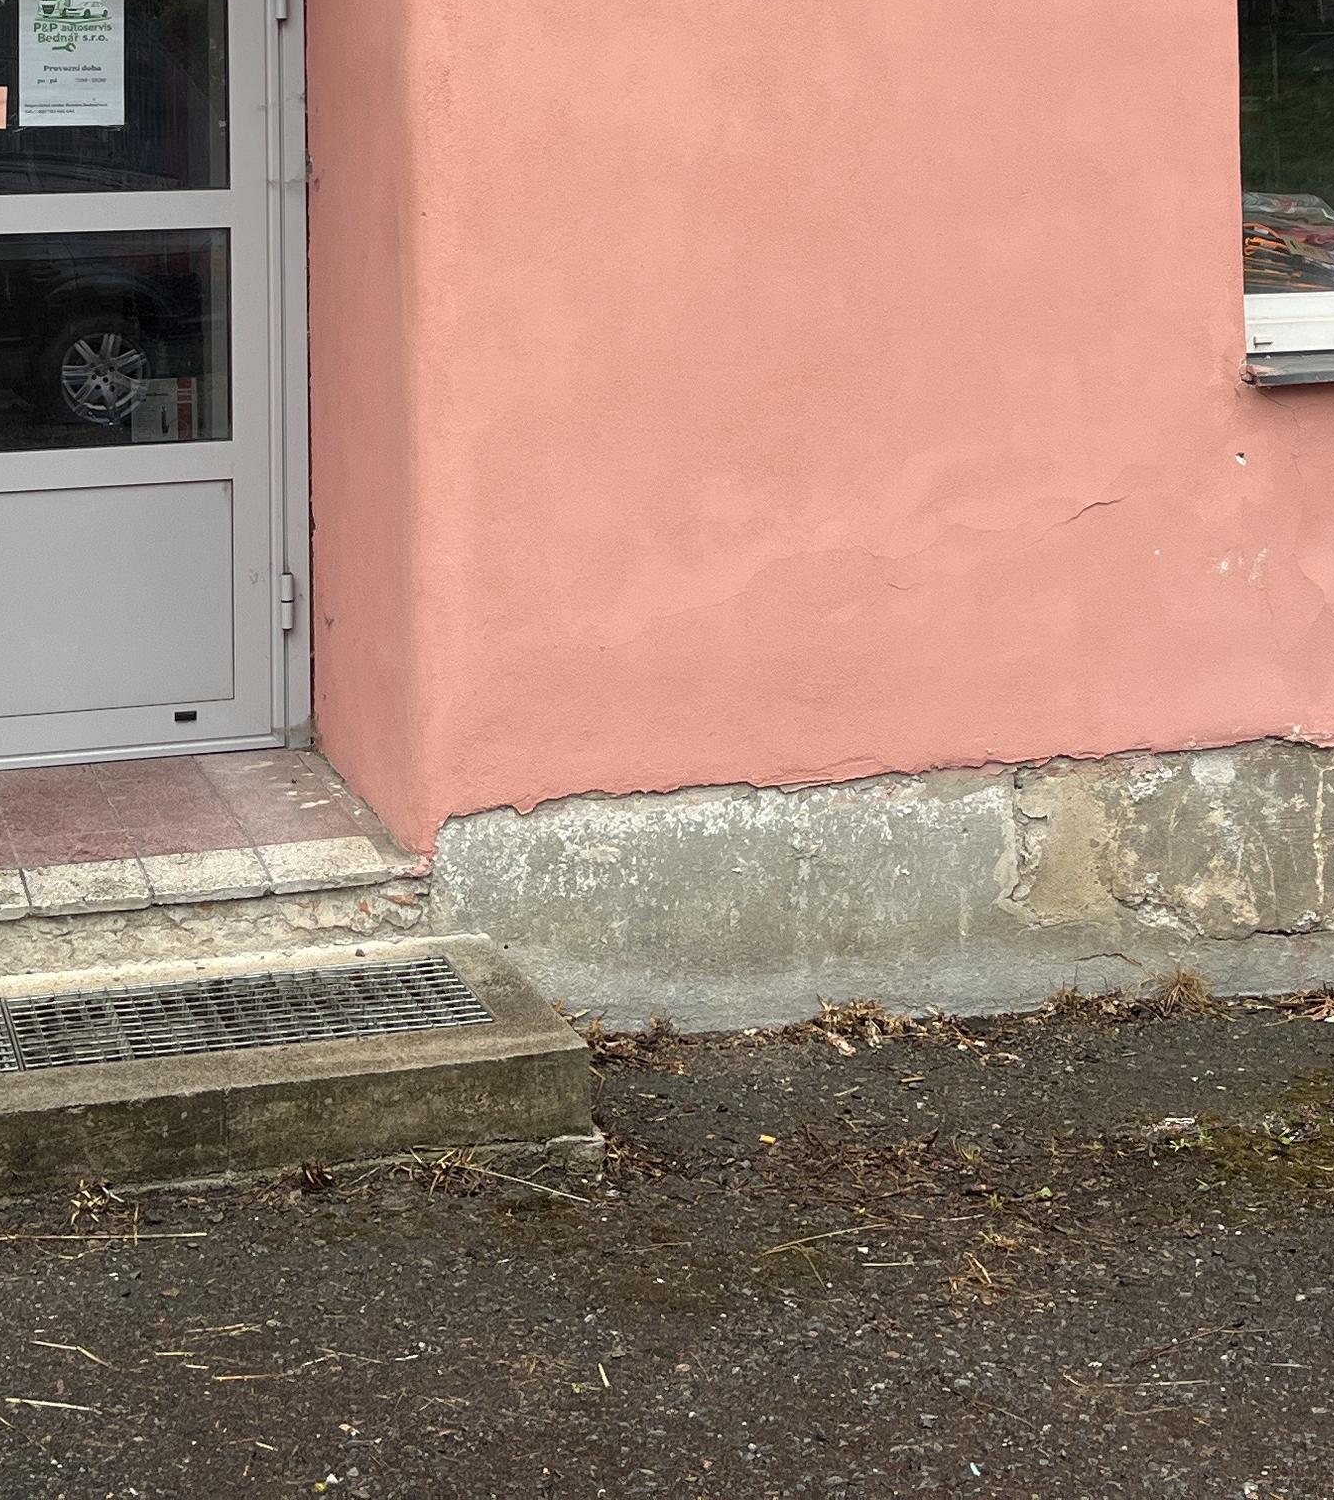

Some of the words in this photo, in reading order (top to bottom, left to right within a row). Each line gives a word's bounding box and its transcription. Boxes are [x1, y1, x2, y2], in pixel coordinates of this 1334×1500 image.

[33, 22, 58, 32] P&P
[60, 22, 112, 32] autoservis
[37, 32, 79, 43] Bednář
[82, 34, 109, 42] s.r.o.
[81, 64, 102, 72] doba
